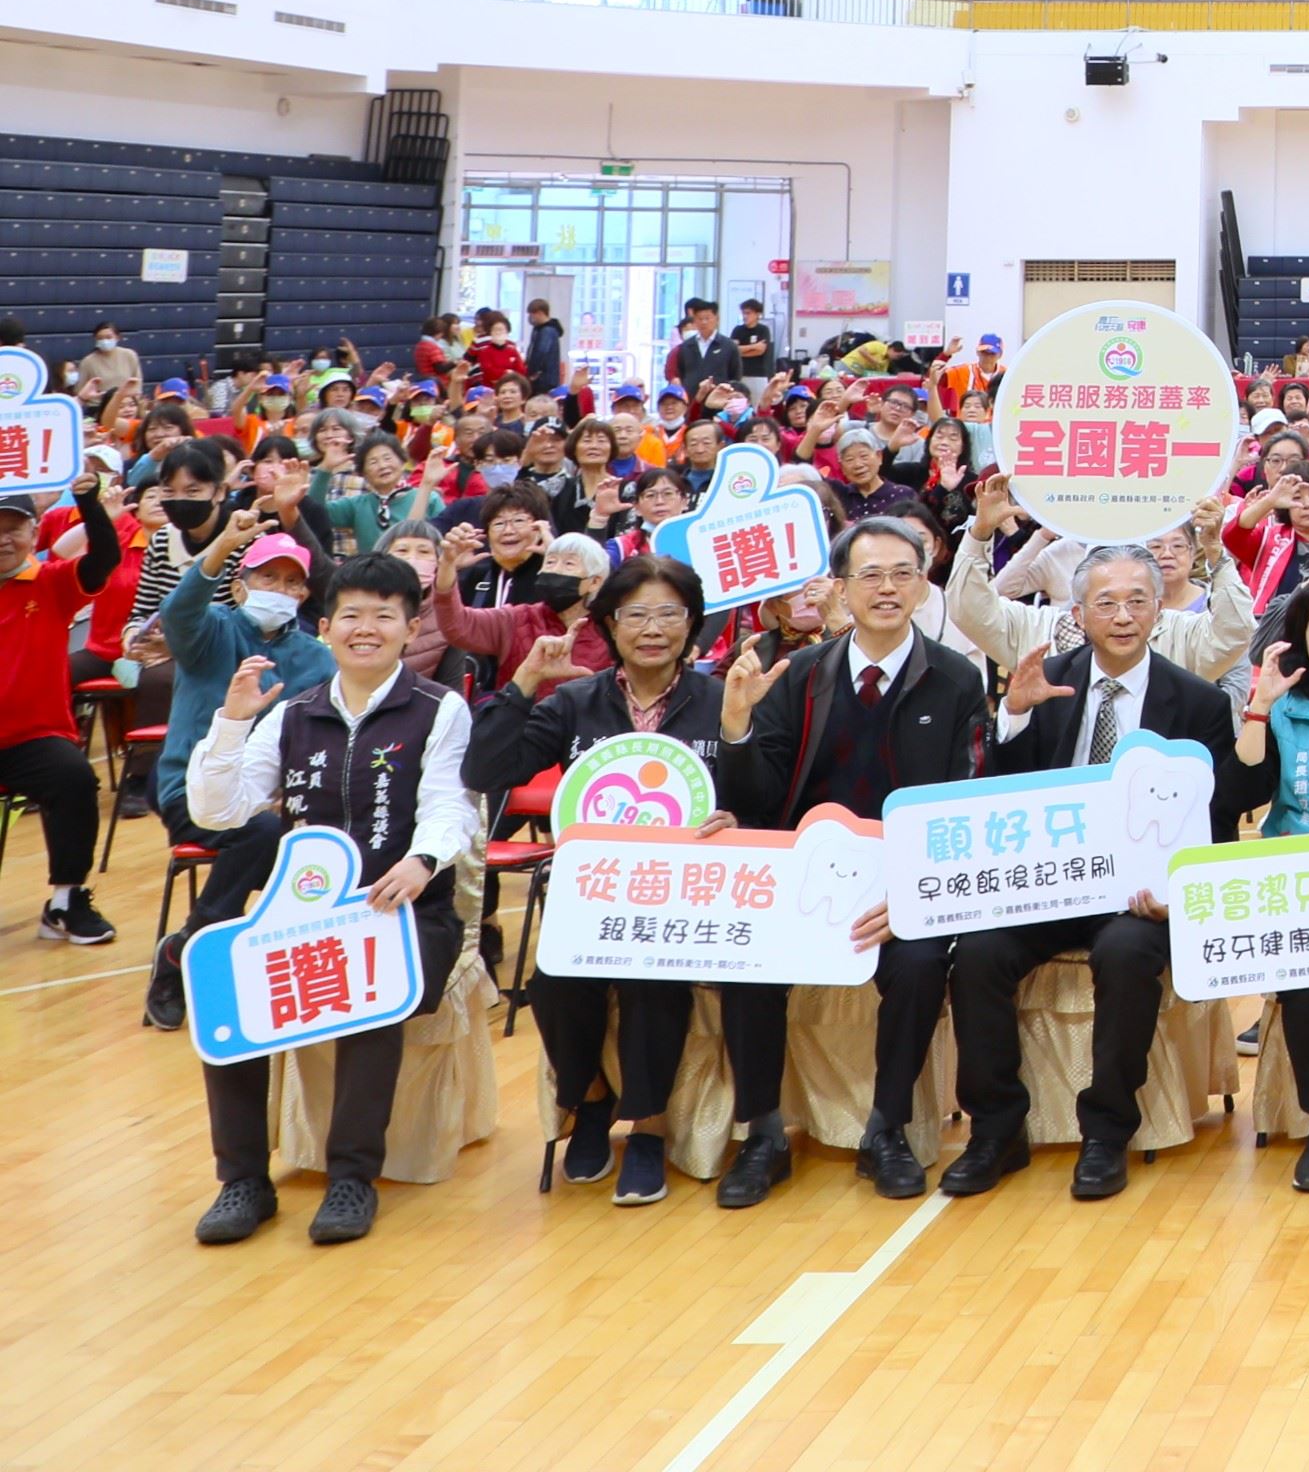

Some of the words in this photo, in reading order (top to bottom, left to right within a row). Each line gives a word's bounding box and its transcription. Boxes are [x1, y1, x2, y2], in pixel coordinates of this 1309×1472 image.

[1020, 384, 1212, 411] 長照服務涵蓋率
[1014, 420, 1221, 478] 全國第一
[712, 522, 798, 593] 讚!
[926, 802, 1087, 864] 顧好牙
[576, 857, 777, 910] 從齒開始
[917, 854, 1116, 902] 早晚飯後記得刷
[598, 915, 753, 946] 銀髮好生活
[265, 936, 377, 1030] 讚!
